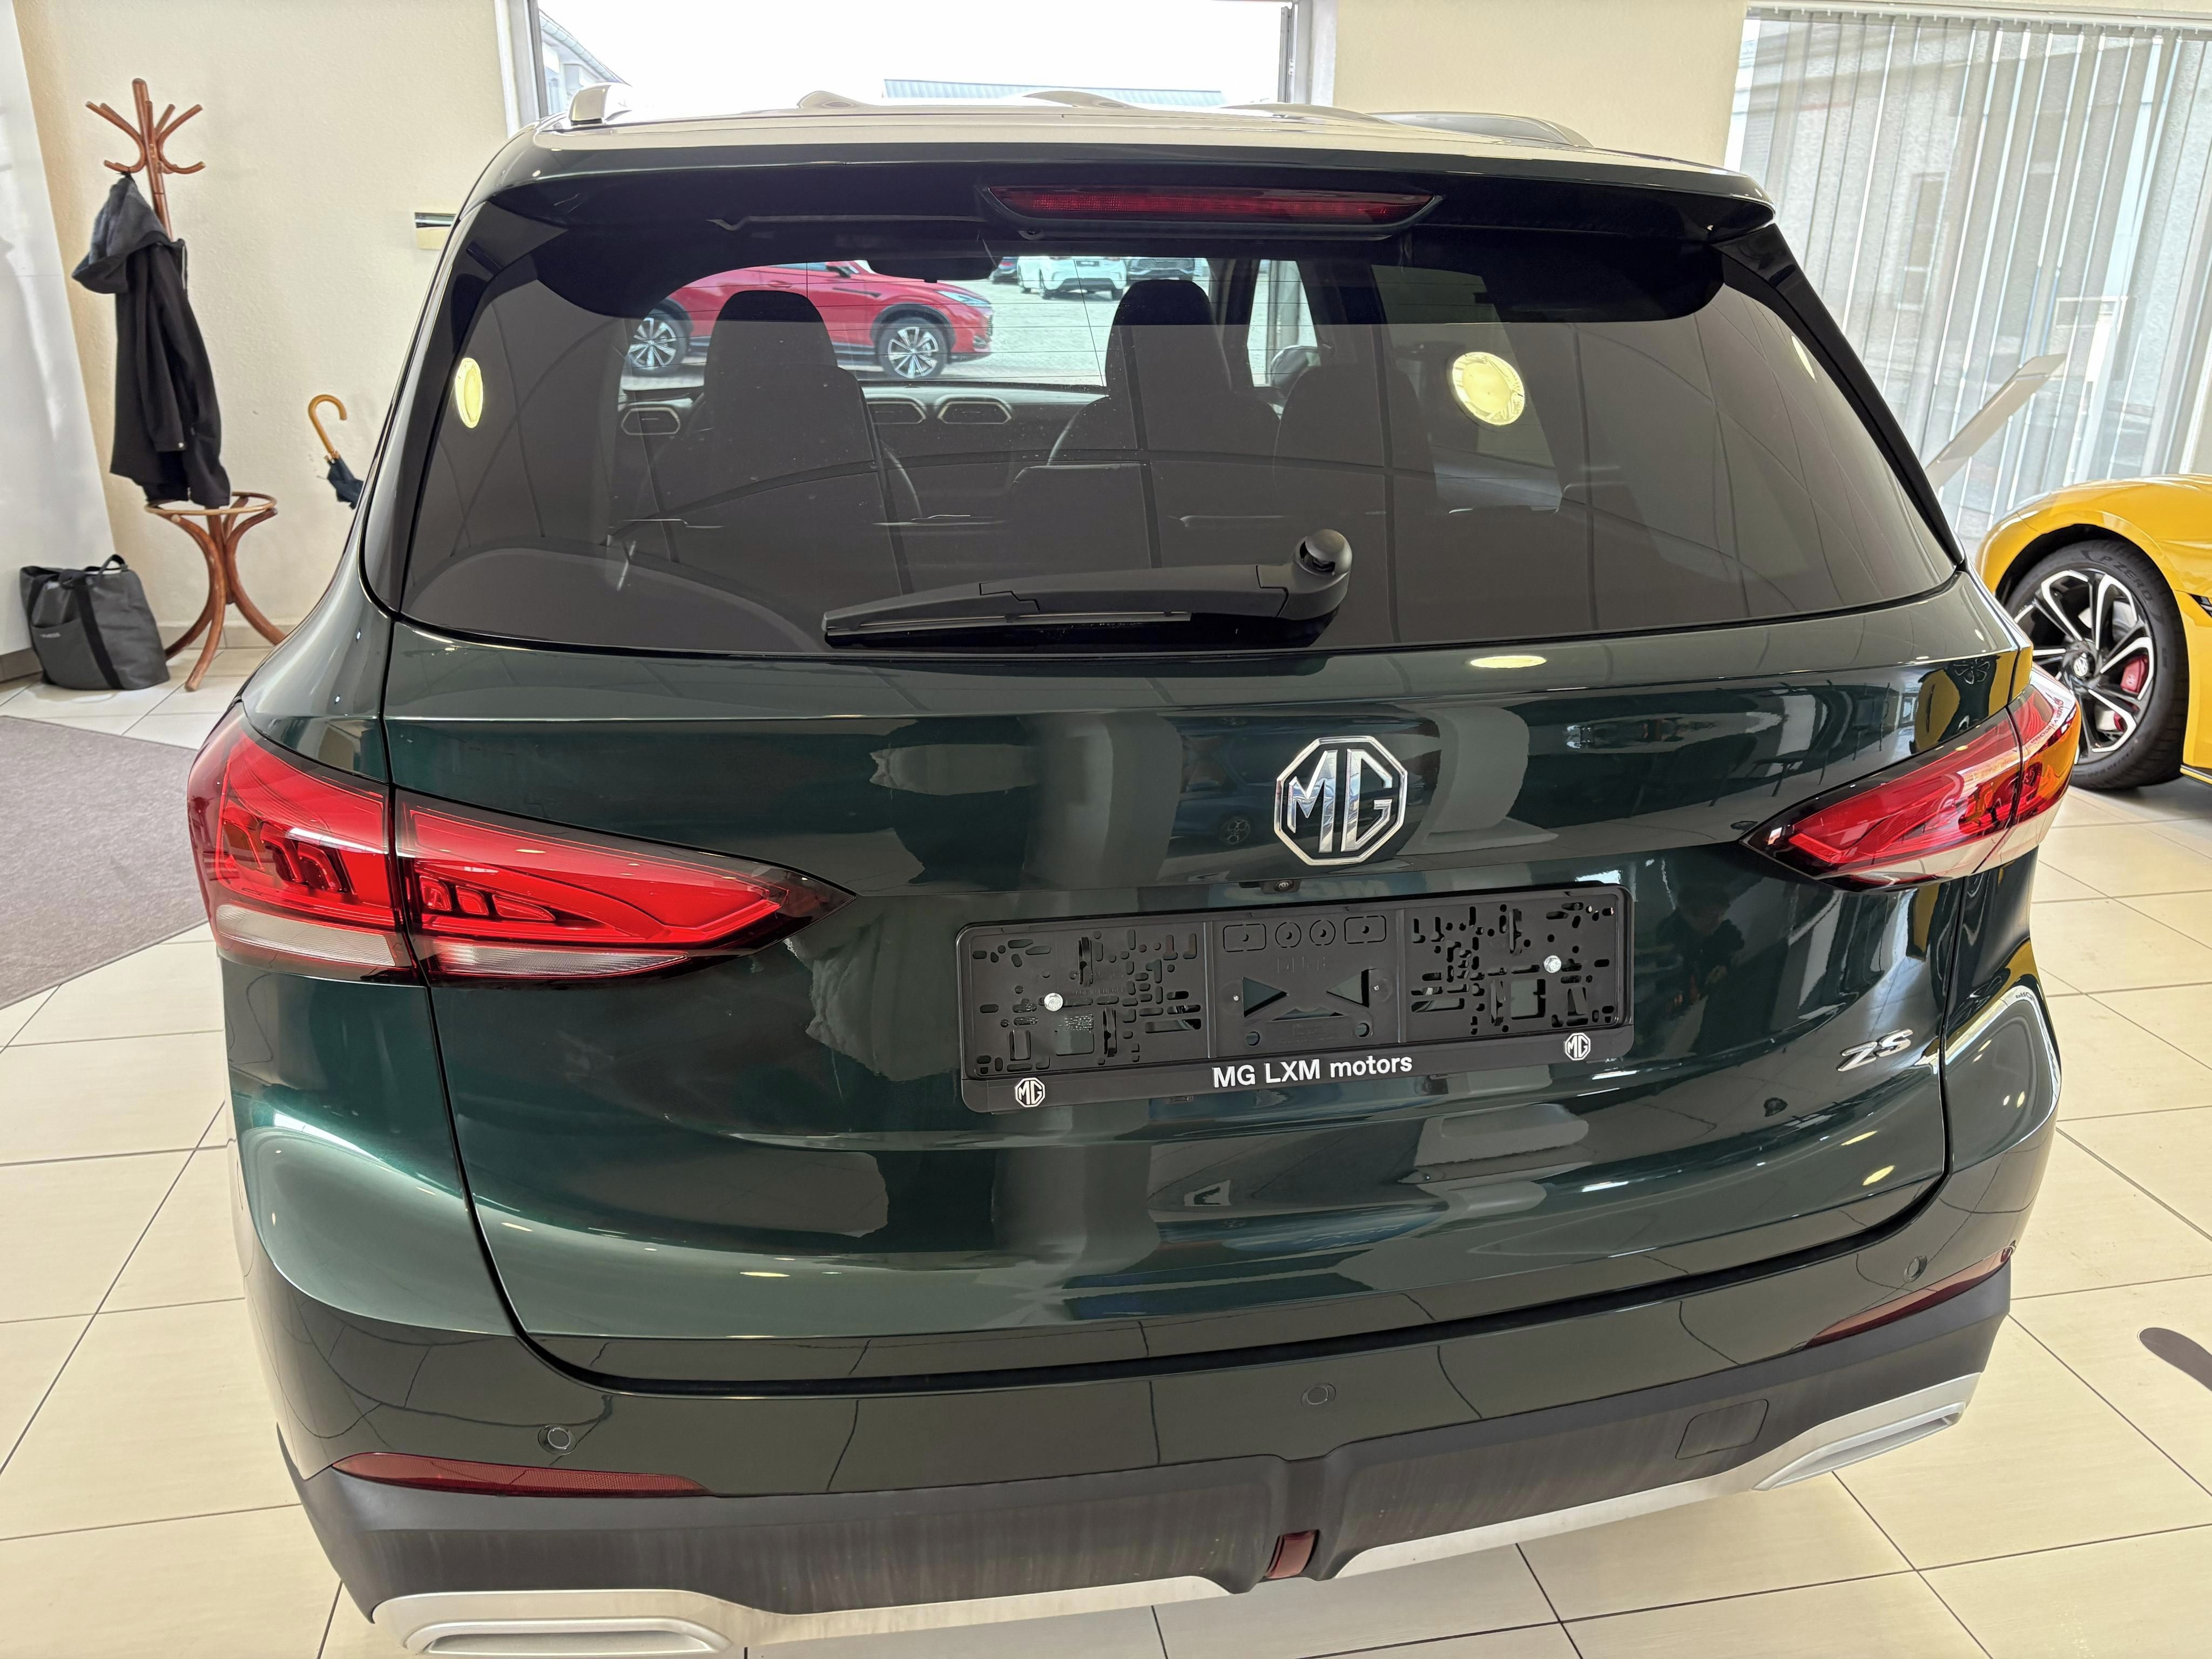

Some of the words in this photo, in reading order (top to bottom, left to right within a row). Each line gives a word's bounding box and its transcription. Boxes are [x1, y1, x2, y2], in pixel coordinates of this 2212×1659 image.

[2113, 561, 2154, 602] ZERO
[1284, 746, 1395, 856] MG
[1567, 1034, 1589, 1059] MG
[1837, 1028, 1914, 1072] ZS
[1212, 1064, 1256, 1088] MG
[1264, 1058, 1321, 1084] LXM
[1330, 1055, 1413, 1078] motors
[1017, 1080, 1044, 1105] MG
